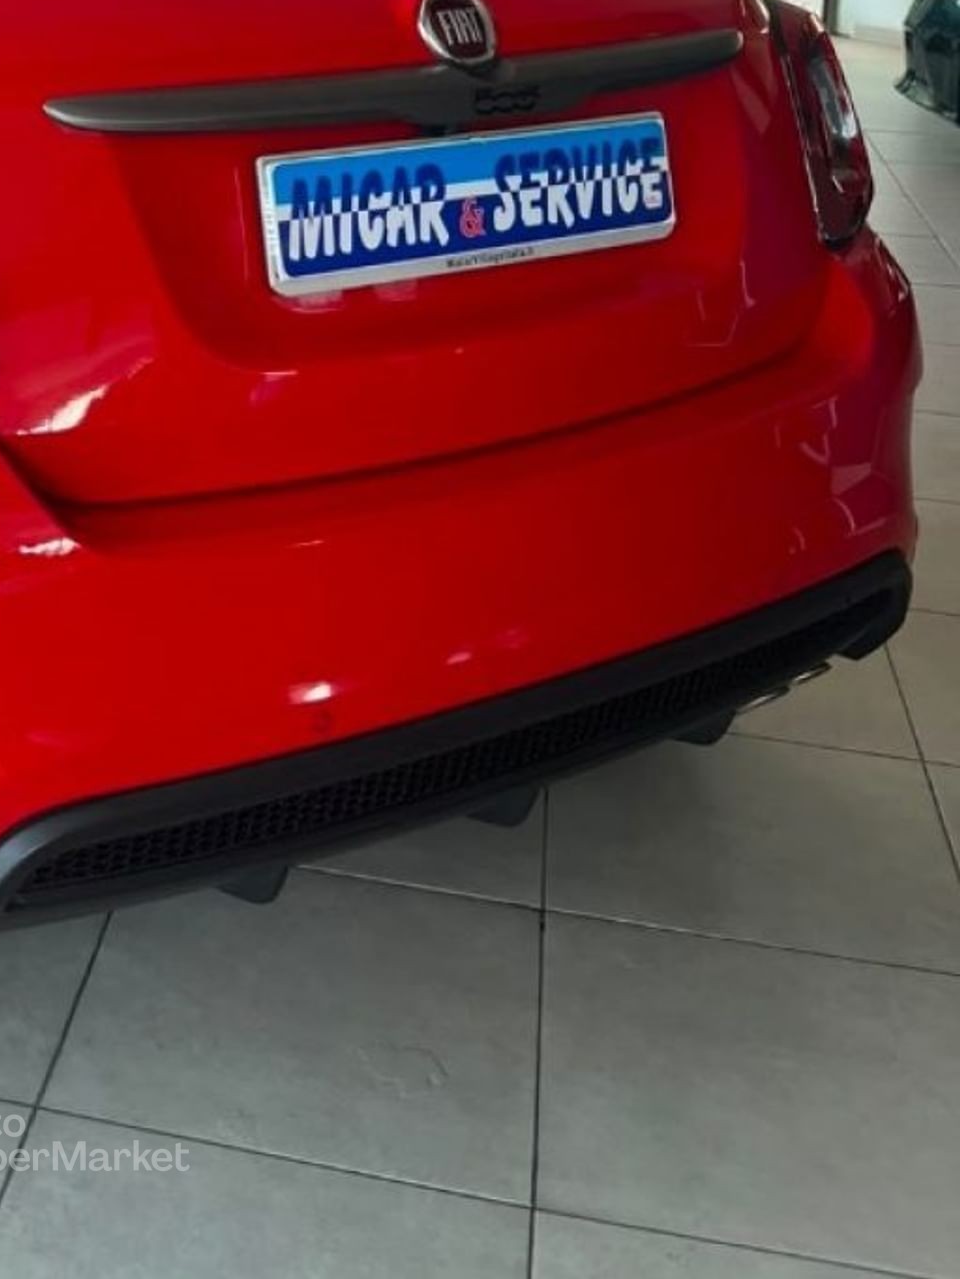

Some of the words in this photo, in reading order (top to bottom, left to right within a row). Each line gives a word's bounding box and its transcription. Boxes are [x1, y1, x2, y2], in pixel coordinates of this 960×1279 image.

[436, 7, 484, 46] FIAT
[288, 162, 449, 261] MICAR
[459, 197, 486, 238] &
[492, 136, 664, 234] SERVICE
